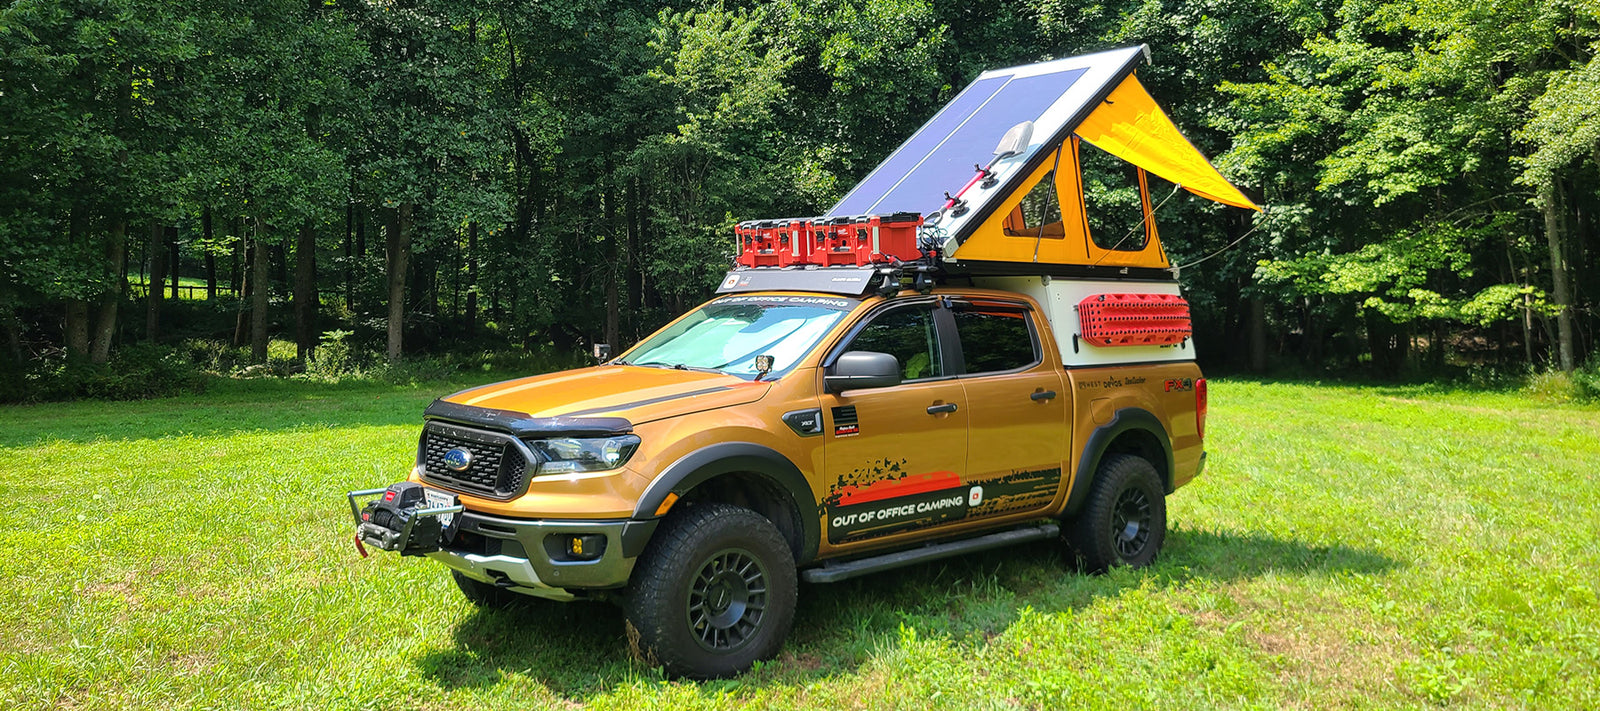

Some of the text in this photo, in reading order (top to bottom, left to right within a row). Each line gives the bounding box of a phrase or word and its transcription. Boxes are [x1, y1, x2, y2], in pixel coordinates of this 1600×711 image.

[789, 297, 848, 307] CAMPING
[1164, 378, 1192, 392] FX4
[832, 496, 964, 528] OUT OF OFFICE CAMPING
